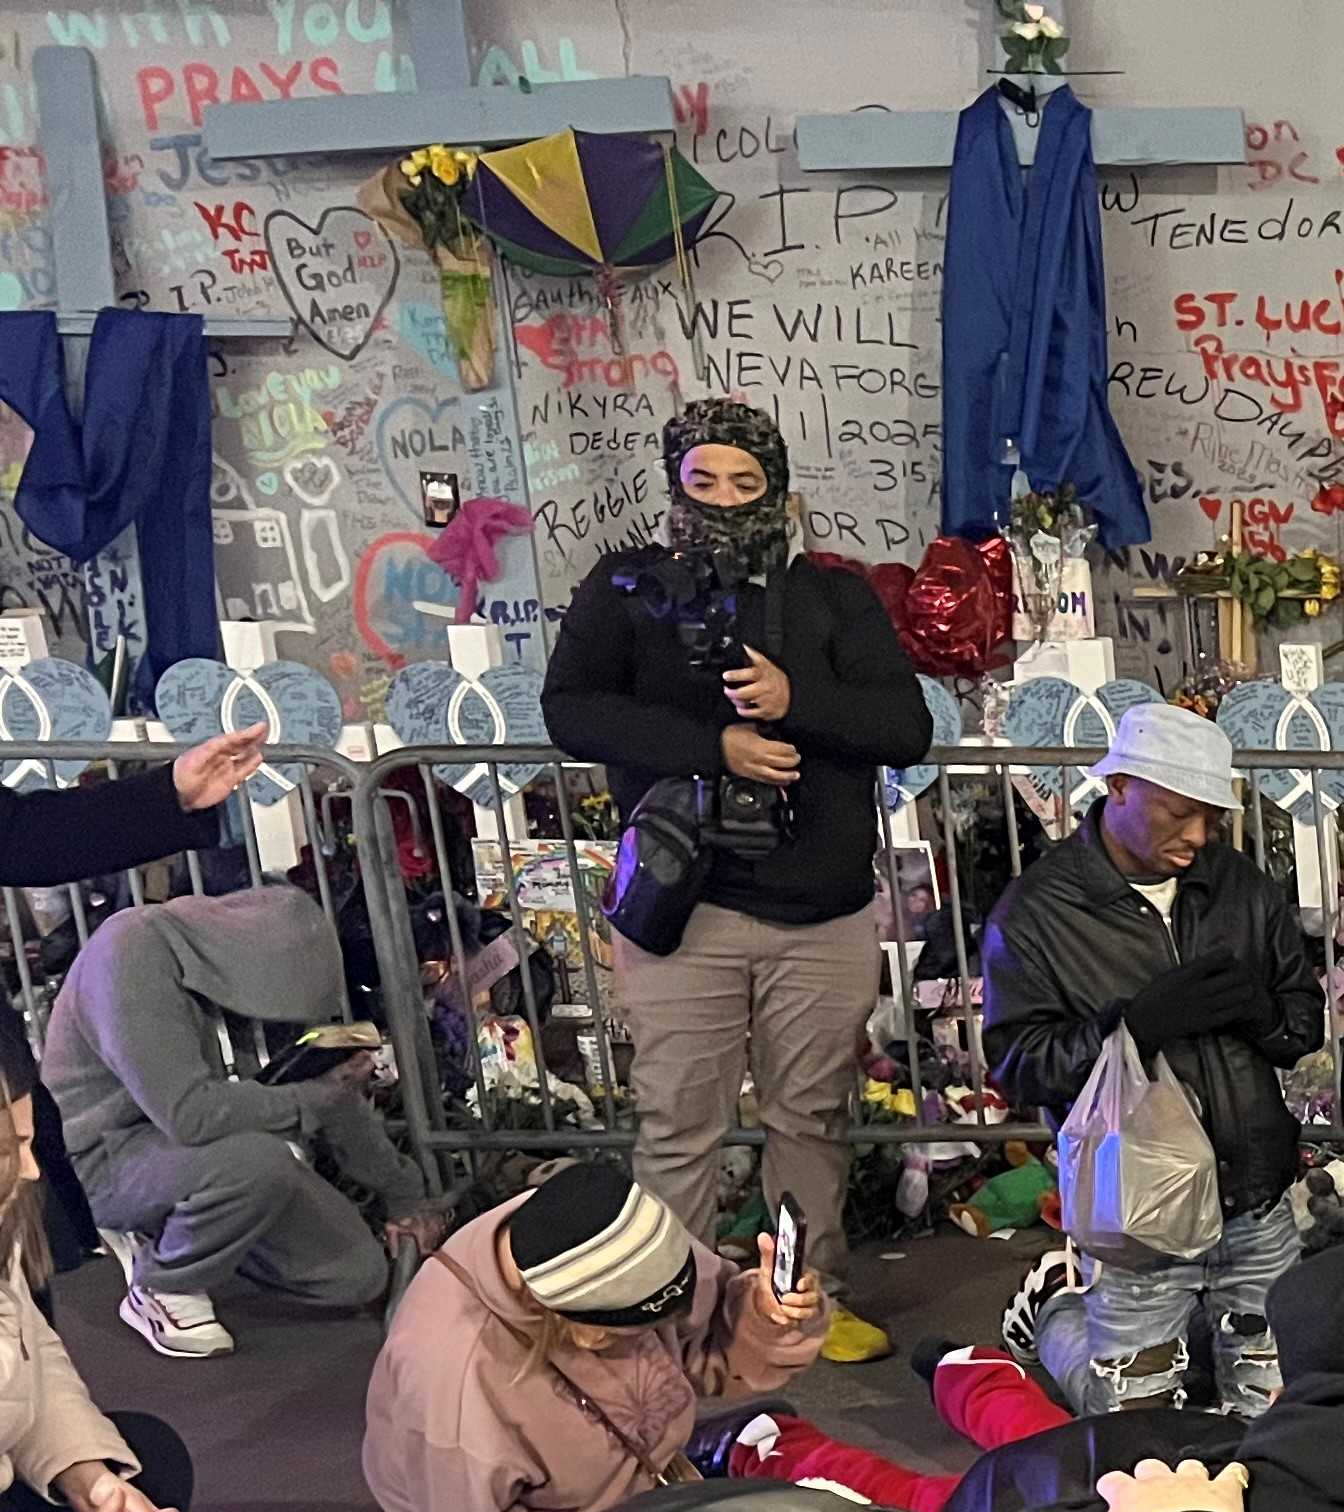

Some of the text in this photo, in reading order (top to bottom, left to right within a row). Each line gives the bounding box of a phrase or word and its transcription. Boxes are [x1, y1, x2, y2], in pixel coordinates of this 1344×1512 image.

[287, 236, 337, 261] But
[294, 259, 359, 293] God
[308, 296, 372, 327] Amen
[676, 299, 920, 351] WE WILL
[1174, 292, 1246, 332] ST.
[704, 347, 824, 394] NEVA
[390, 425, 467, 460] NOLA
